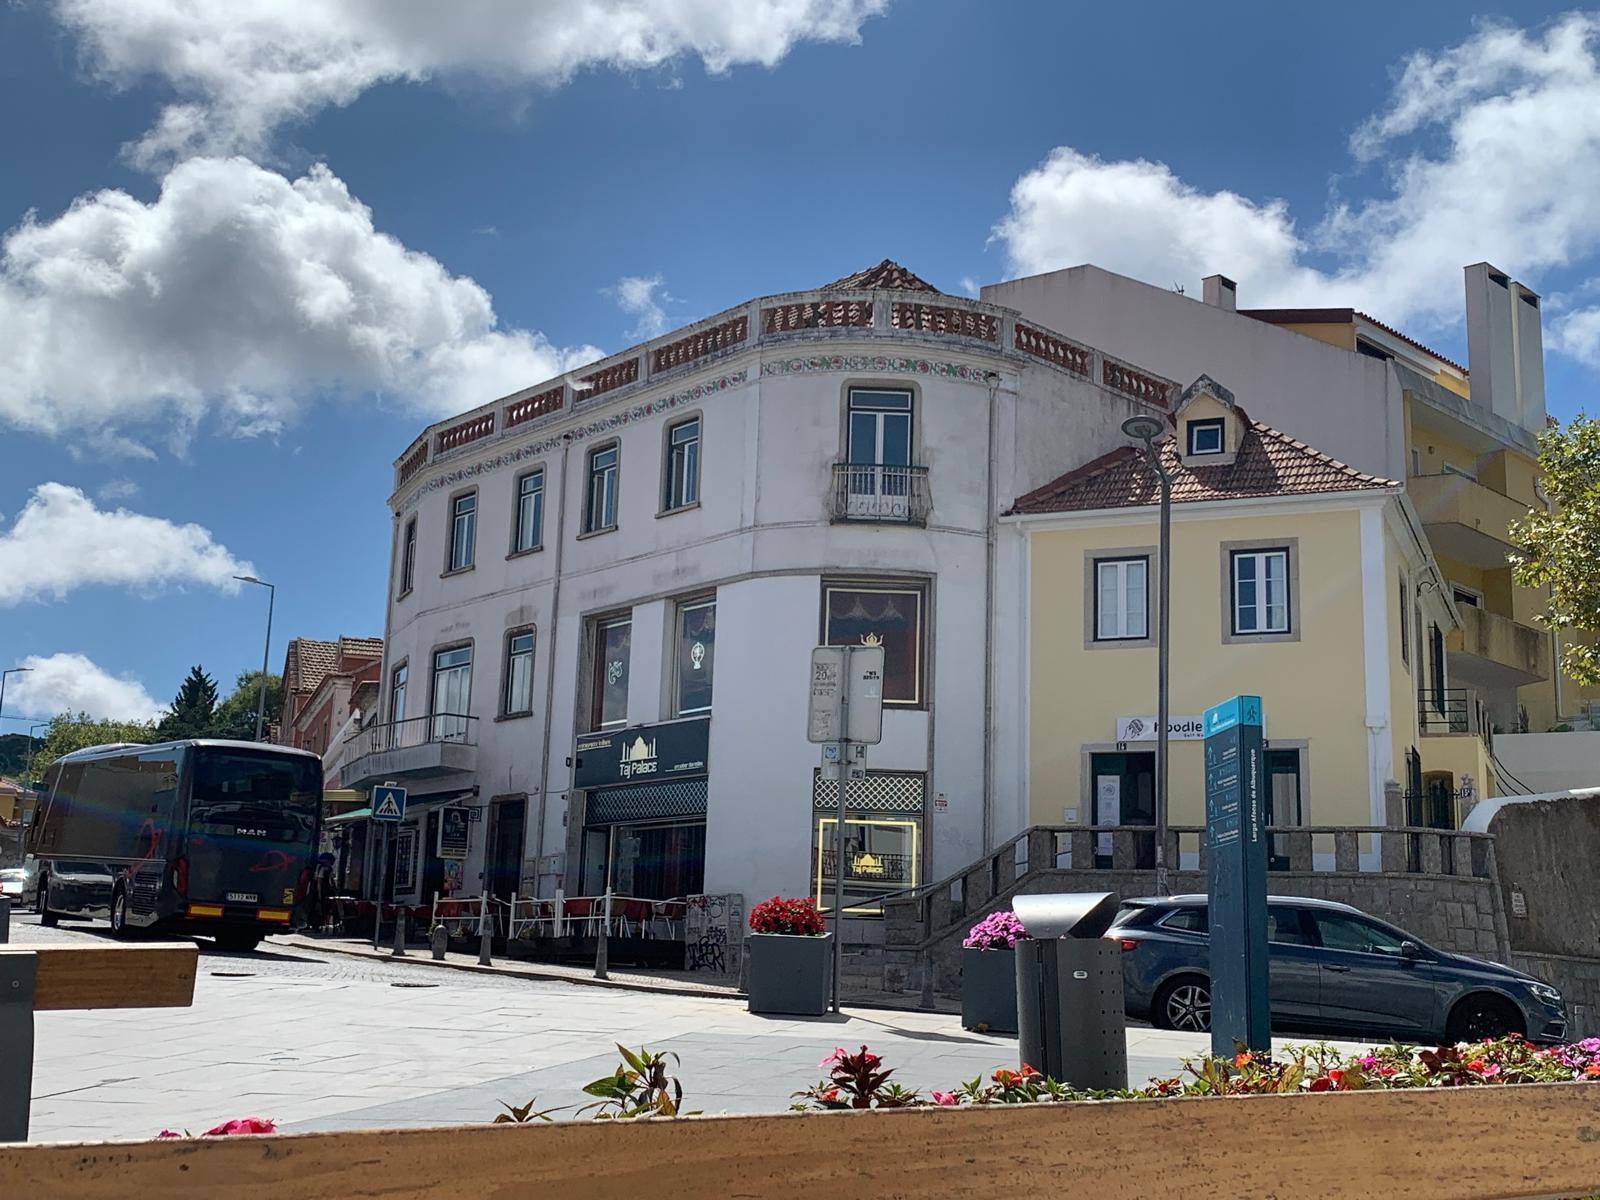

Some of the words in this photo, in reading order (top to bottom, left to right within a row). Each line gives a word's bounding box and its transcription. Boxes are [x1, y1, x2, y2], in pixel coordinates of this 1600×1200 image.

[620, 761, 630, 779] Taj
[631, 760, 658, 775] Palace
[1249, 749, 1257, 789] Albuquerque
[1250, 790, 1257, 799] de
[237, 828, 267, 837] MAN
[1250, 823, 1258, 842] Largo
